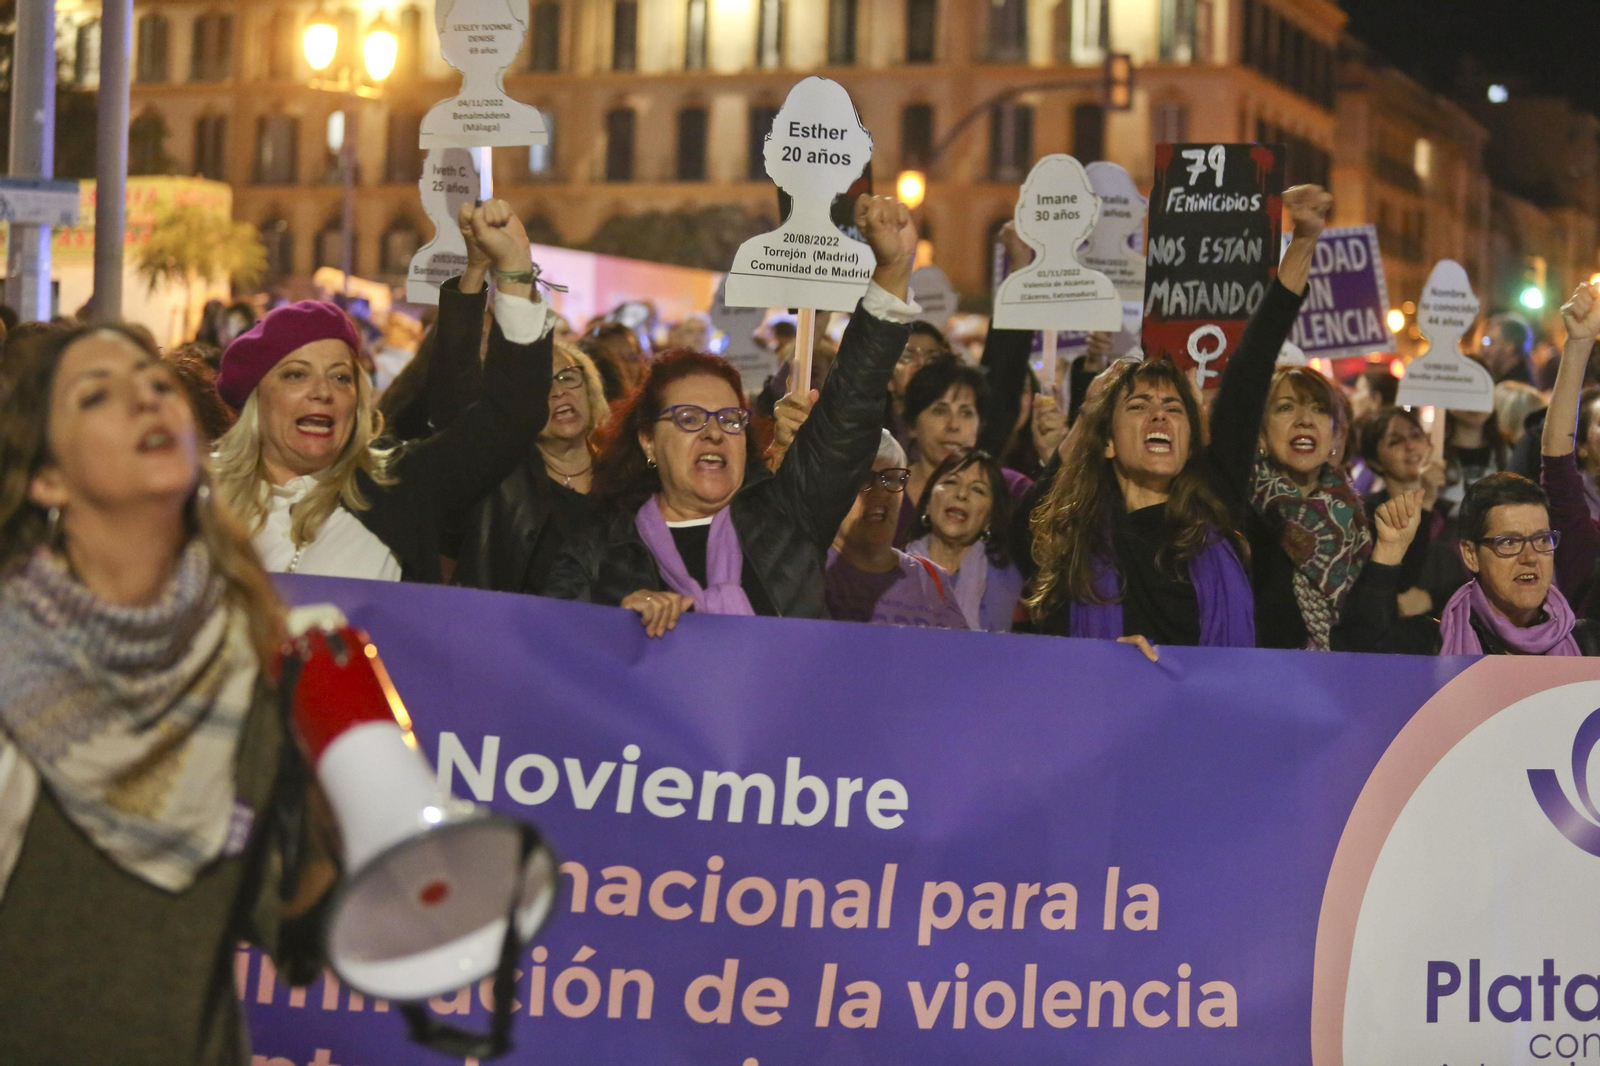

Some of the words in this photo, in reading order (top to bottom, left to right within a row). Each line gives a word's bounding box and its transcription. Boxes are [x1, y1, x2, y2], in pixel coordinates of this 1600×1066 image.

[453, 23, 480, 32] LESLEY
[480, 46, 498, 55] años
[457, 99, 504, 107] 04/11/2022
[452, 111, 510, 121] Benalmádena
[462, 123, 500, 133] (Málaga)
[788, 121, 848, 141] Esther
[781, 146, 801, 162] 20
[806, 148, 851, 166] años
[432, 164, 456, 177] Iveth
[1181, 144, 1226, 188] 79
[432, 180, 444, 192] 25
[446, 182, 470, 195] años
[1036, 193, 1078, 206] Imane
[1034, 210, 1050, 221] 30
[1053, 209, 1081, 221] años
[783, 232, 840, 247] 20/08/2022
[1147, 235, 1186, 267] NOS
[1198, 228, 1263, 265] ESTÁN
[762, 246, 807, 260] Torrejón
[812, 250, 859, 265] (Madrid)
[750, 259, 812, 275] Comunidad
[814, 265, 828, 276] de
[831, 266, 870, 279] Madrid
[1037, 268, 1081, 278] 01/11/2022
[1144, 277, 1264, 318] MATANDO
[436, 731, 909, 830] Noviembre
[917, 879, 1079, 946] para
[1102, 866, 1160, 932] la
[684, 957, 790, 1027] de
[814, 962, 882, 1029] la
[907, 961, 1239, 1030] violencia
[1426, 958, 1600, 1023] Plata
